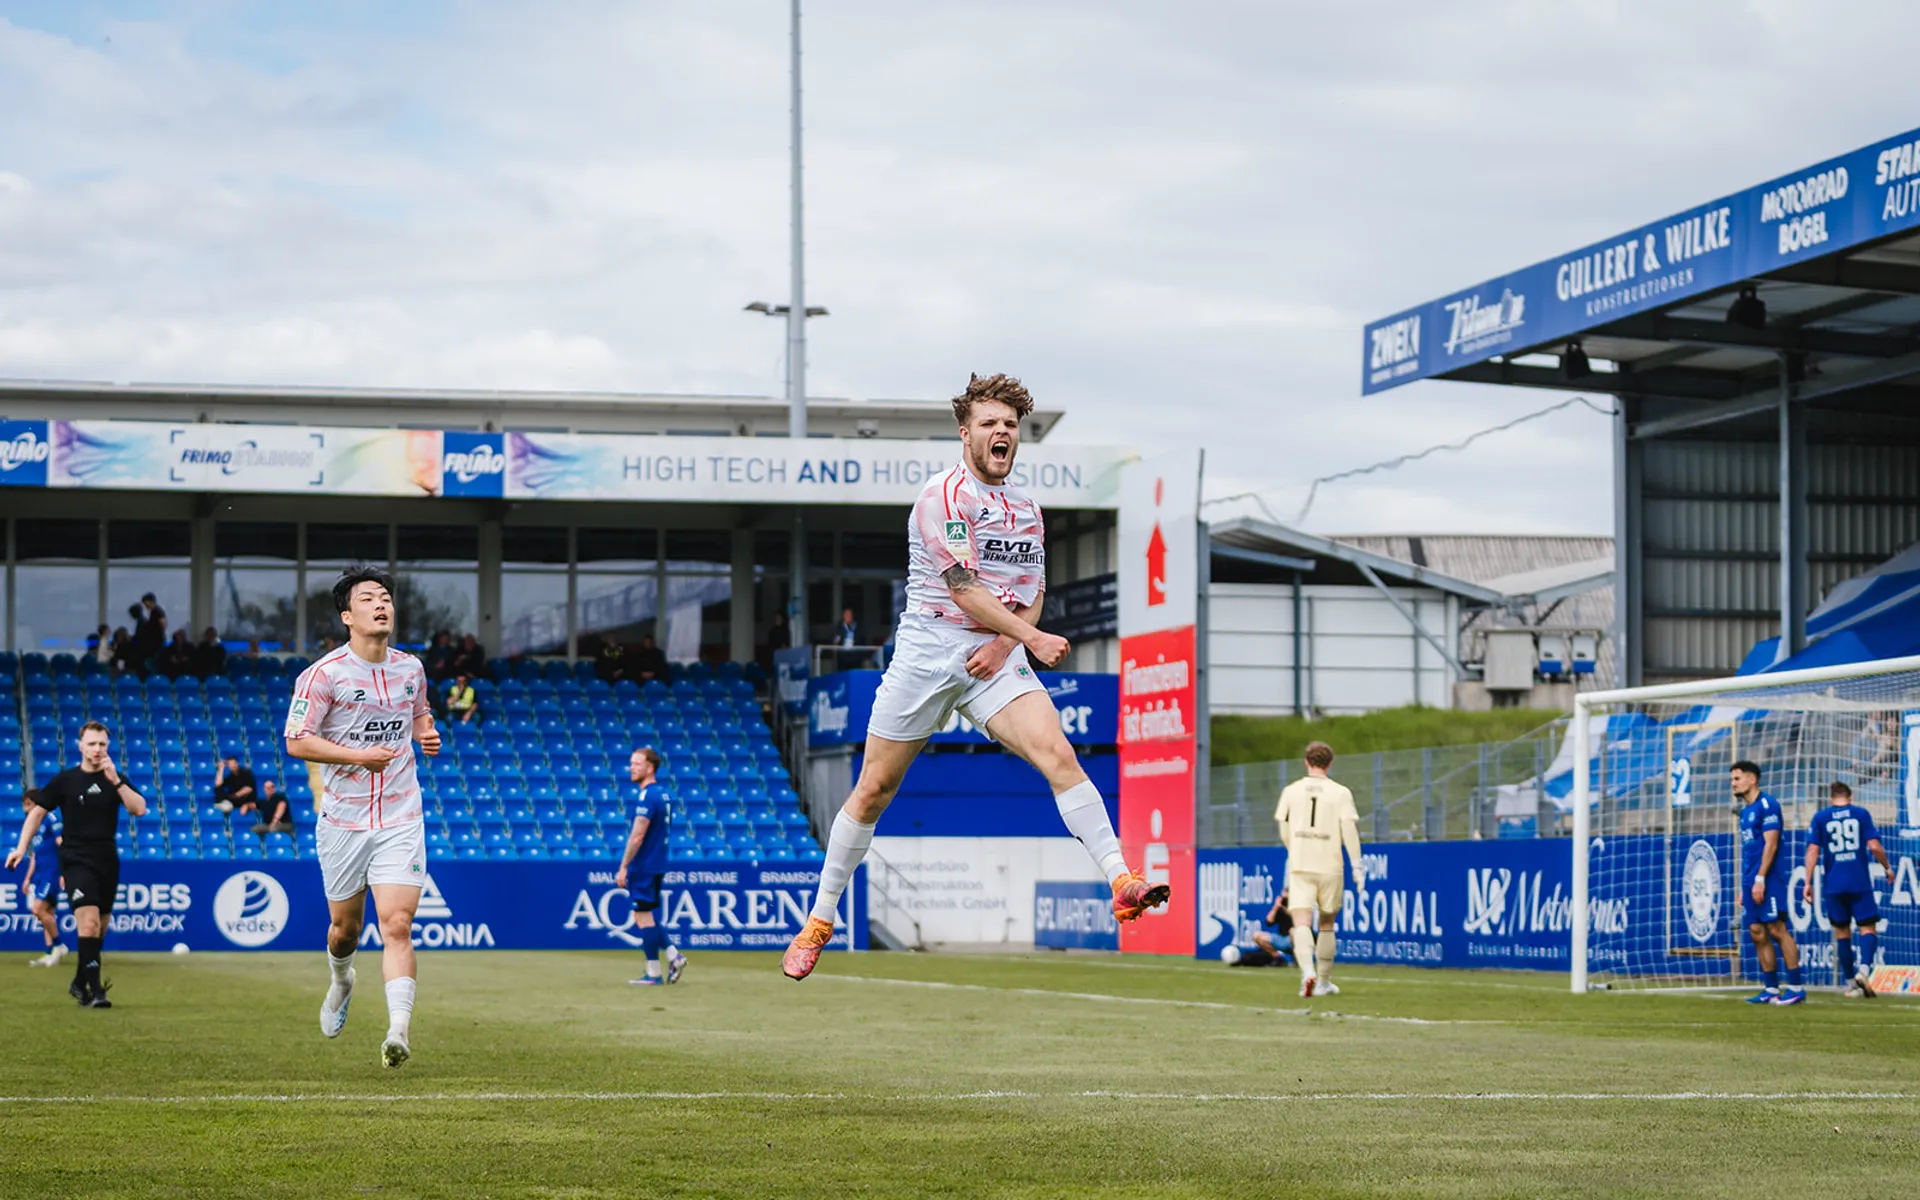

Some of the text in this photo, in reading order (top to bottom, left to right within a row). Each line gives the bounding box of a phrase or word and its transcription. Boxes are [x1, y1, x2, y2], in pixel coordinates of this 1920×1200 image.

[1760, 167, 1849, 223] MOTORRAD
[1882, 178, 1920, 221] AUT
[1779, 211, 1828, 255] BÖGEL
[1557, 207, 1731, 301] GULLERT & WILKE
[1586, 268, 1694, 317] KONSTRUKTIONEN
[181, 448, 232, 464] FRIMO
[443, 449, 505, 476] FRIMO
[623, 456, 696, 482] HIGH
[706, 457, 787, 484] TECH
[797, 460, 861, 485] AND
[984, 539, 1032, 553] evo
[364, 720, 403, 731] evo
[1310, 796, 1317, 827] 1
[1826, 818, 1860, 853] 39
[226, 917, 277, 933] vedes
[359, 922, 496, 947] ACONIA
